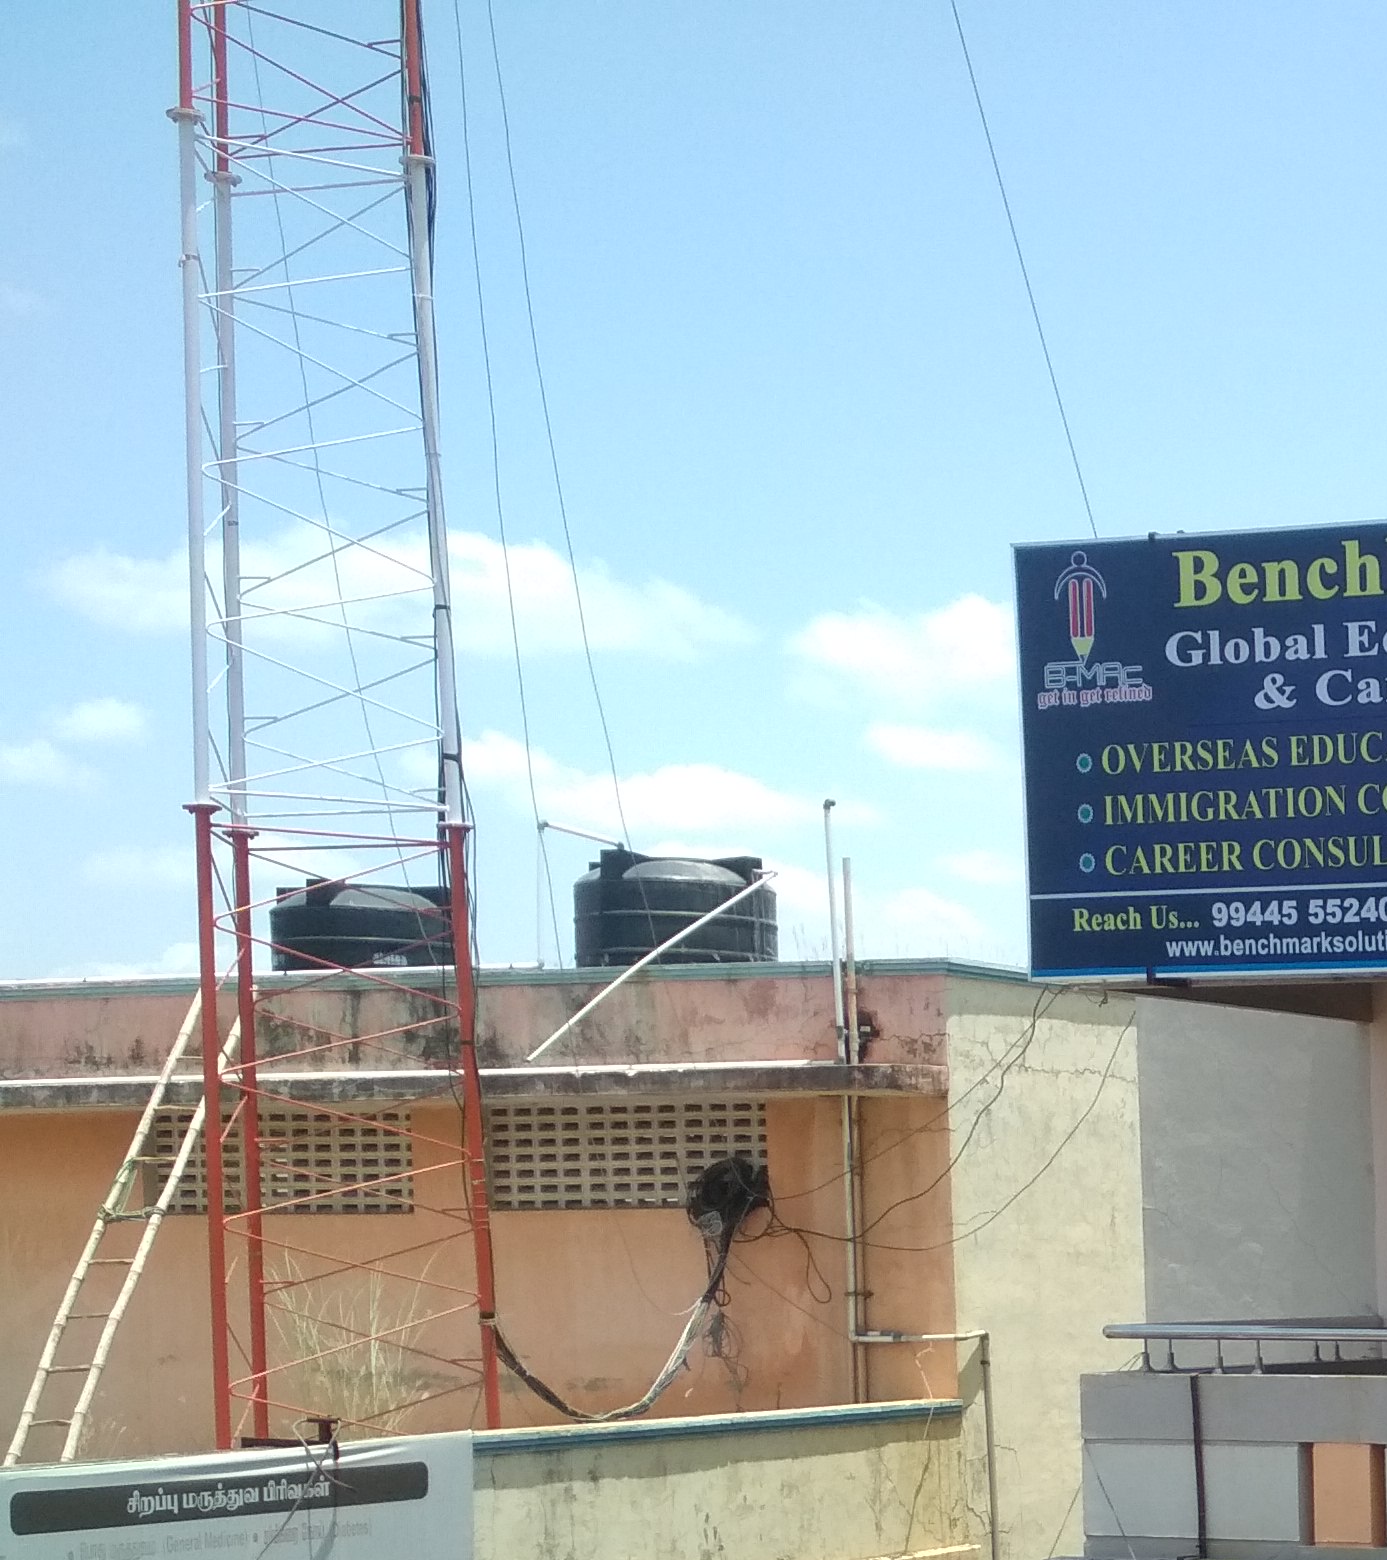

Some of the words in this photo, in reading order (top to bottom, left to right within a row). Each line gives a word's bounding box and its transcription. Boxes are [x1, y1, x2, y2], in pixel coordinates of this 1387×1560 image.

[1165, 625, 1328, 667] Global
[1102, 736, 1278, 776] OVERSEAS
[1104, 784, 1347, 826] IMMIGRATION
[1104, 836, 1242, 876] CAREER
[1073, 905, 1143, 933] Reach
[1212, 899, 1299, 927] 99445
[127, 1486, 179, 1517] சிறப்பு
[183, 1483, 259, 1512] மருத்துவ
